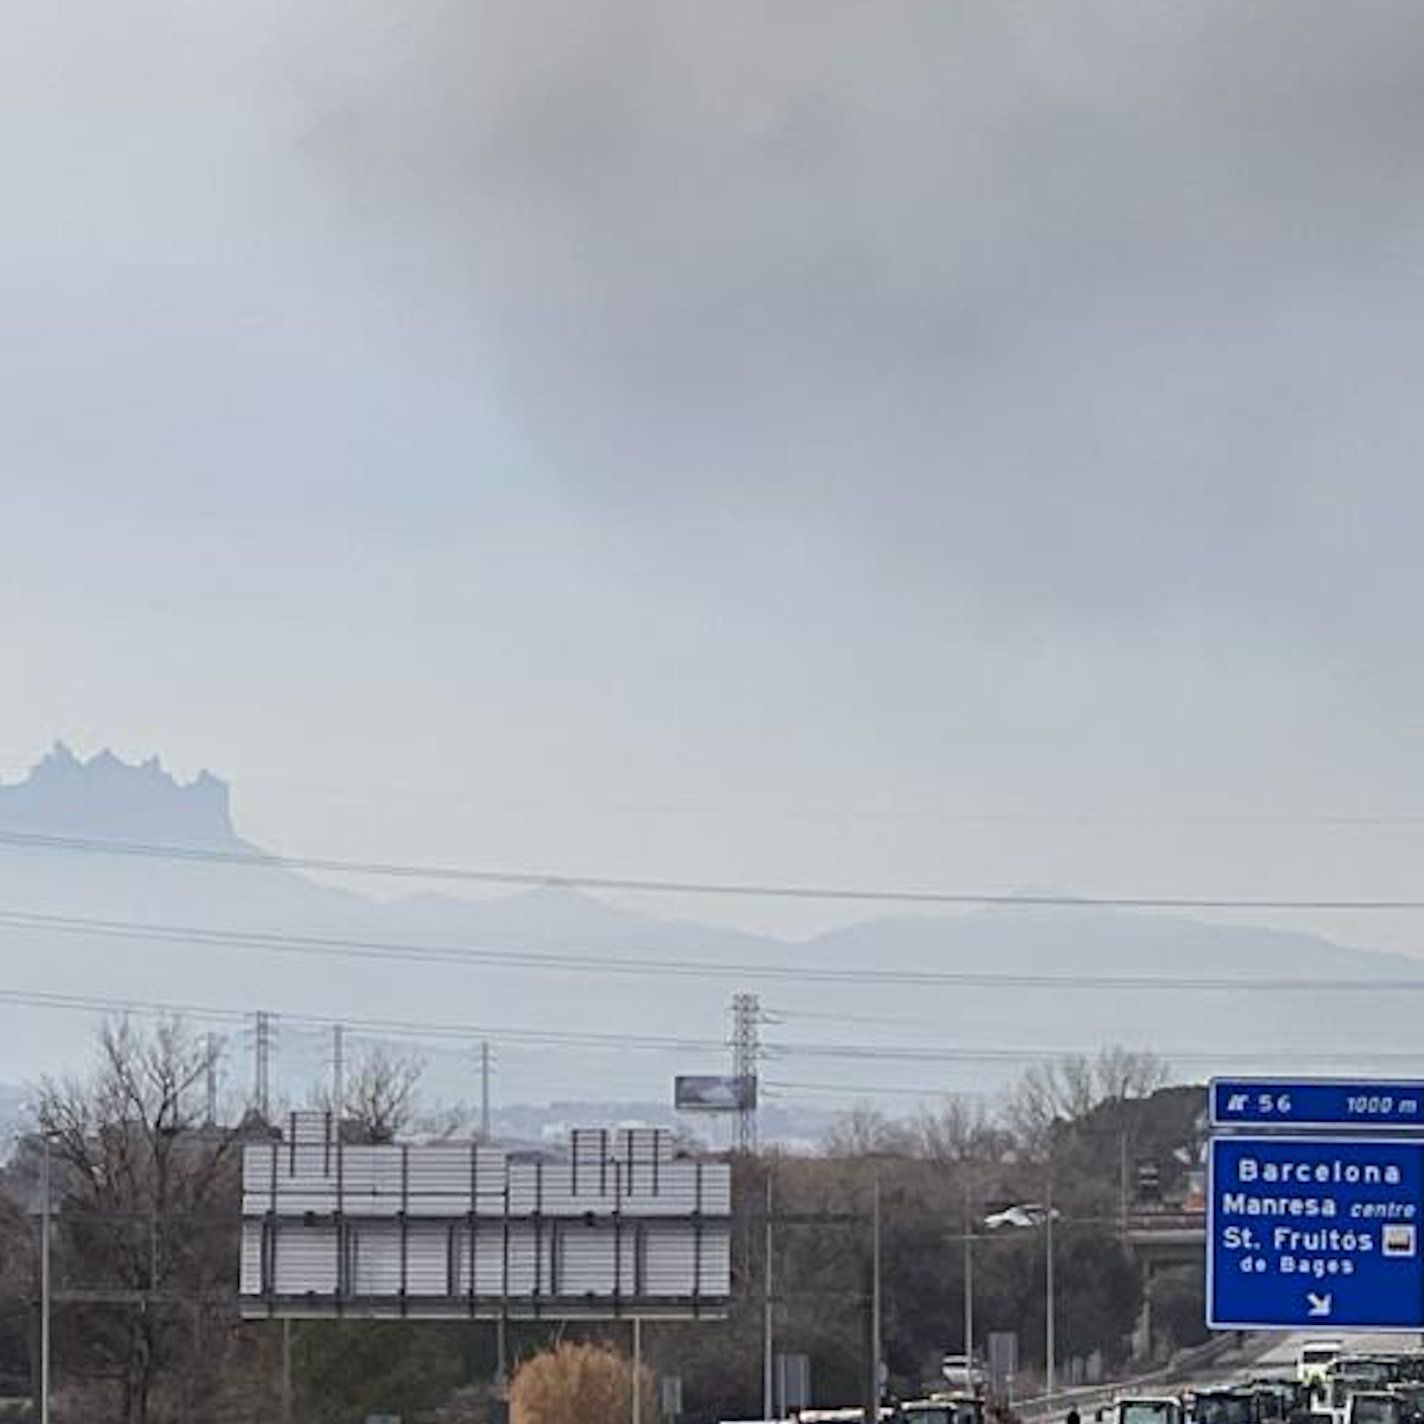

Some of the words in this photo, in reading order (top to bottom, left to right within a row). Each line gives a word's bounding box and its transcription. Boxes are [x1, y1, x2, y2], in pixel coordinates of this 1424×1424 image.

[1258, 1094, 1291, 1113] 56
[1347, 1096, 1393, 1114] 1000
[1398, 1099, 1417, 1113] m
[1239, 1158, 1400, 1183] Barcelona
[1222, 1192, 1337, 1217] Manresa
[1351, 1202, 1416, 1218] centre
[1223, 1225, 1260, 1250] St.
[1274, 1226, 1374, 1251] Fruitós
[1239, 1255, 1267, 1273] de
[1279, 1255, 1355, 1278] Bages
